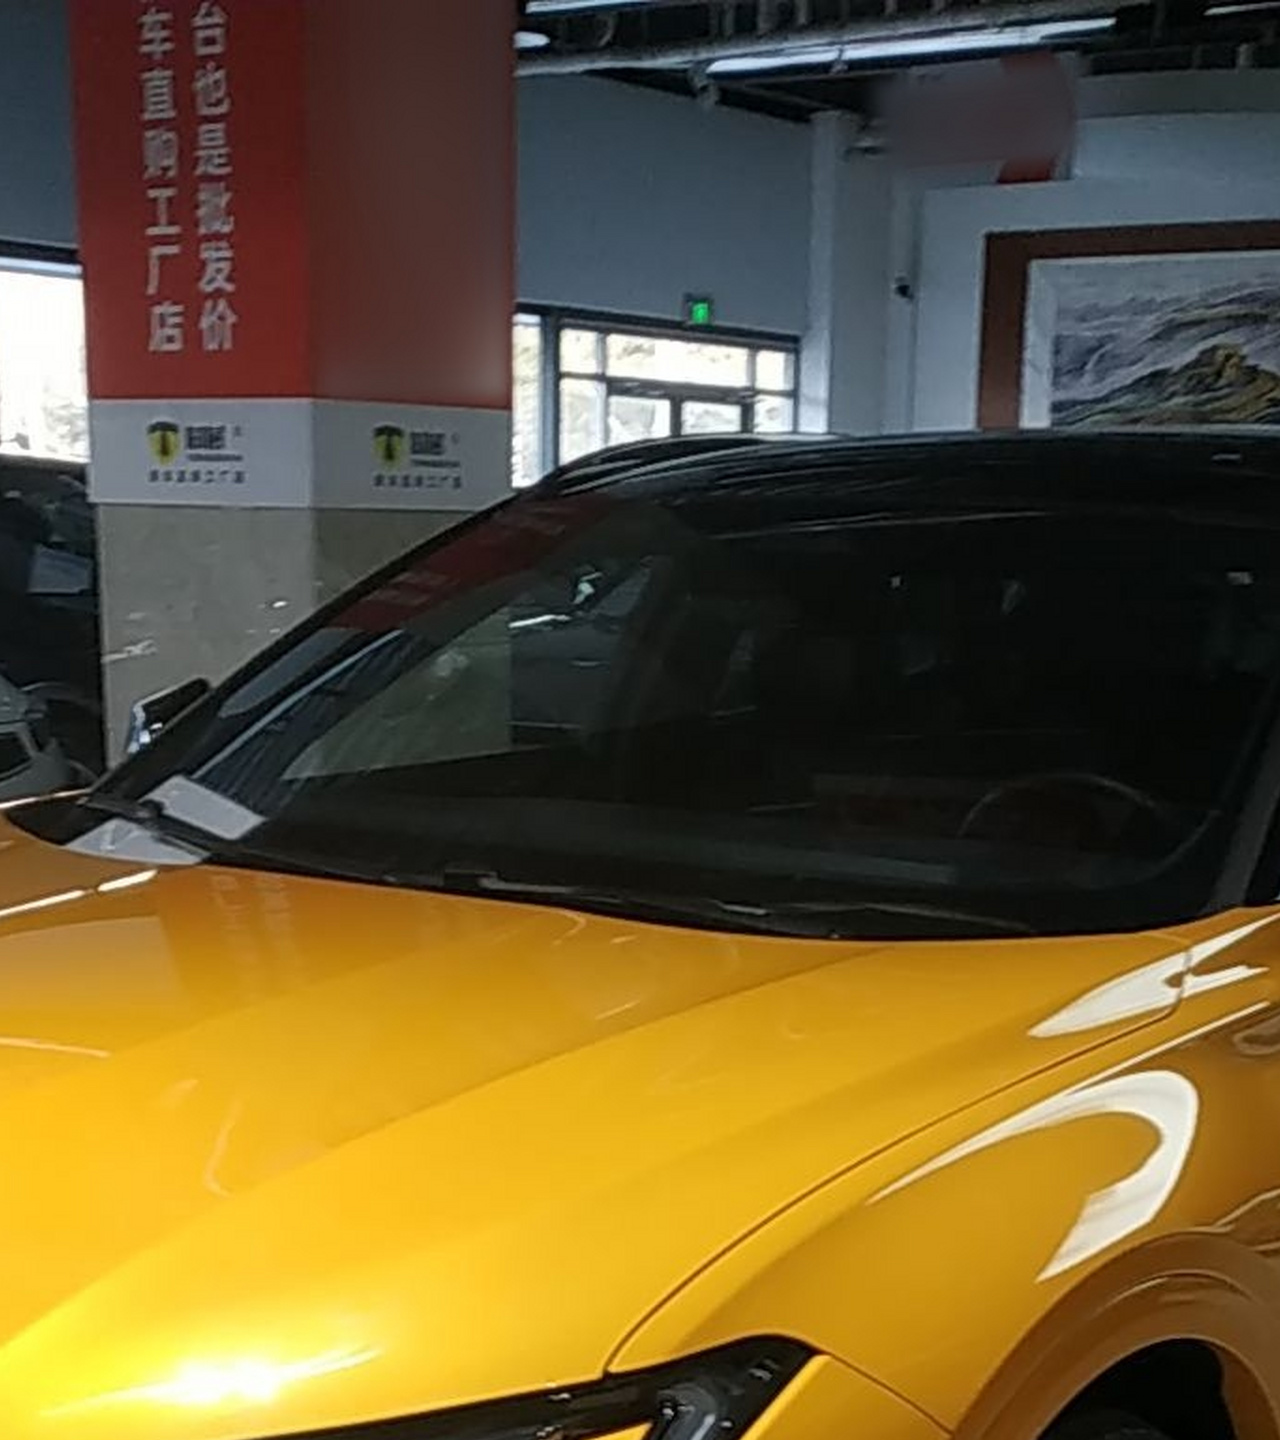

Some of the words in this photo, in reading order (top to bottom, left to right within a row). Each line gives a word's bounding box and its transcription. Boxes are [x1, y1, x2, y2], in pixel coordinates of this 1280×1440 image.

[136, 0, 184, 354] 车直购工厂店
[190, 1, 240, 353] 台也是批发价
